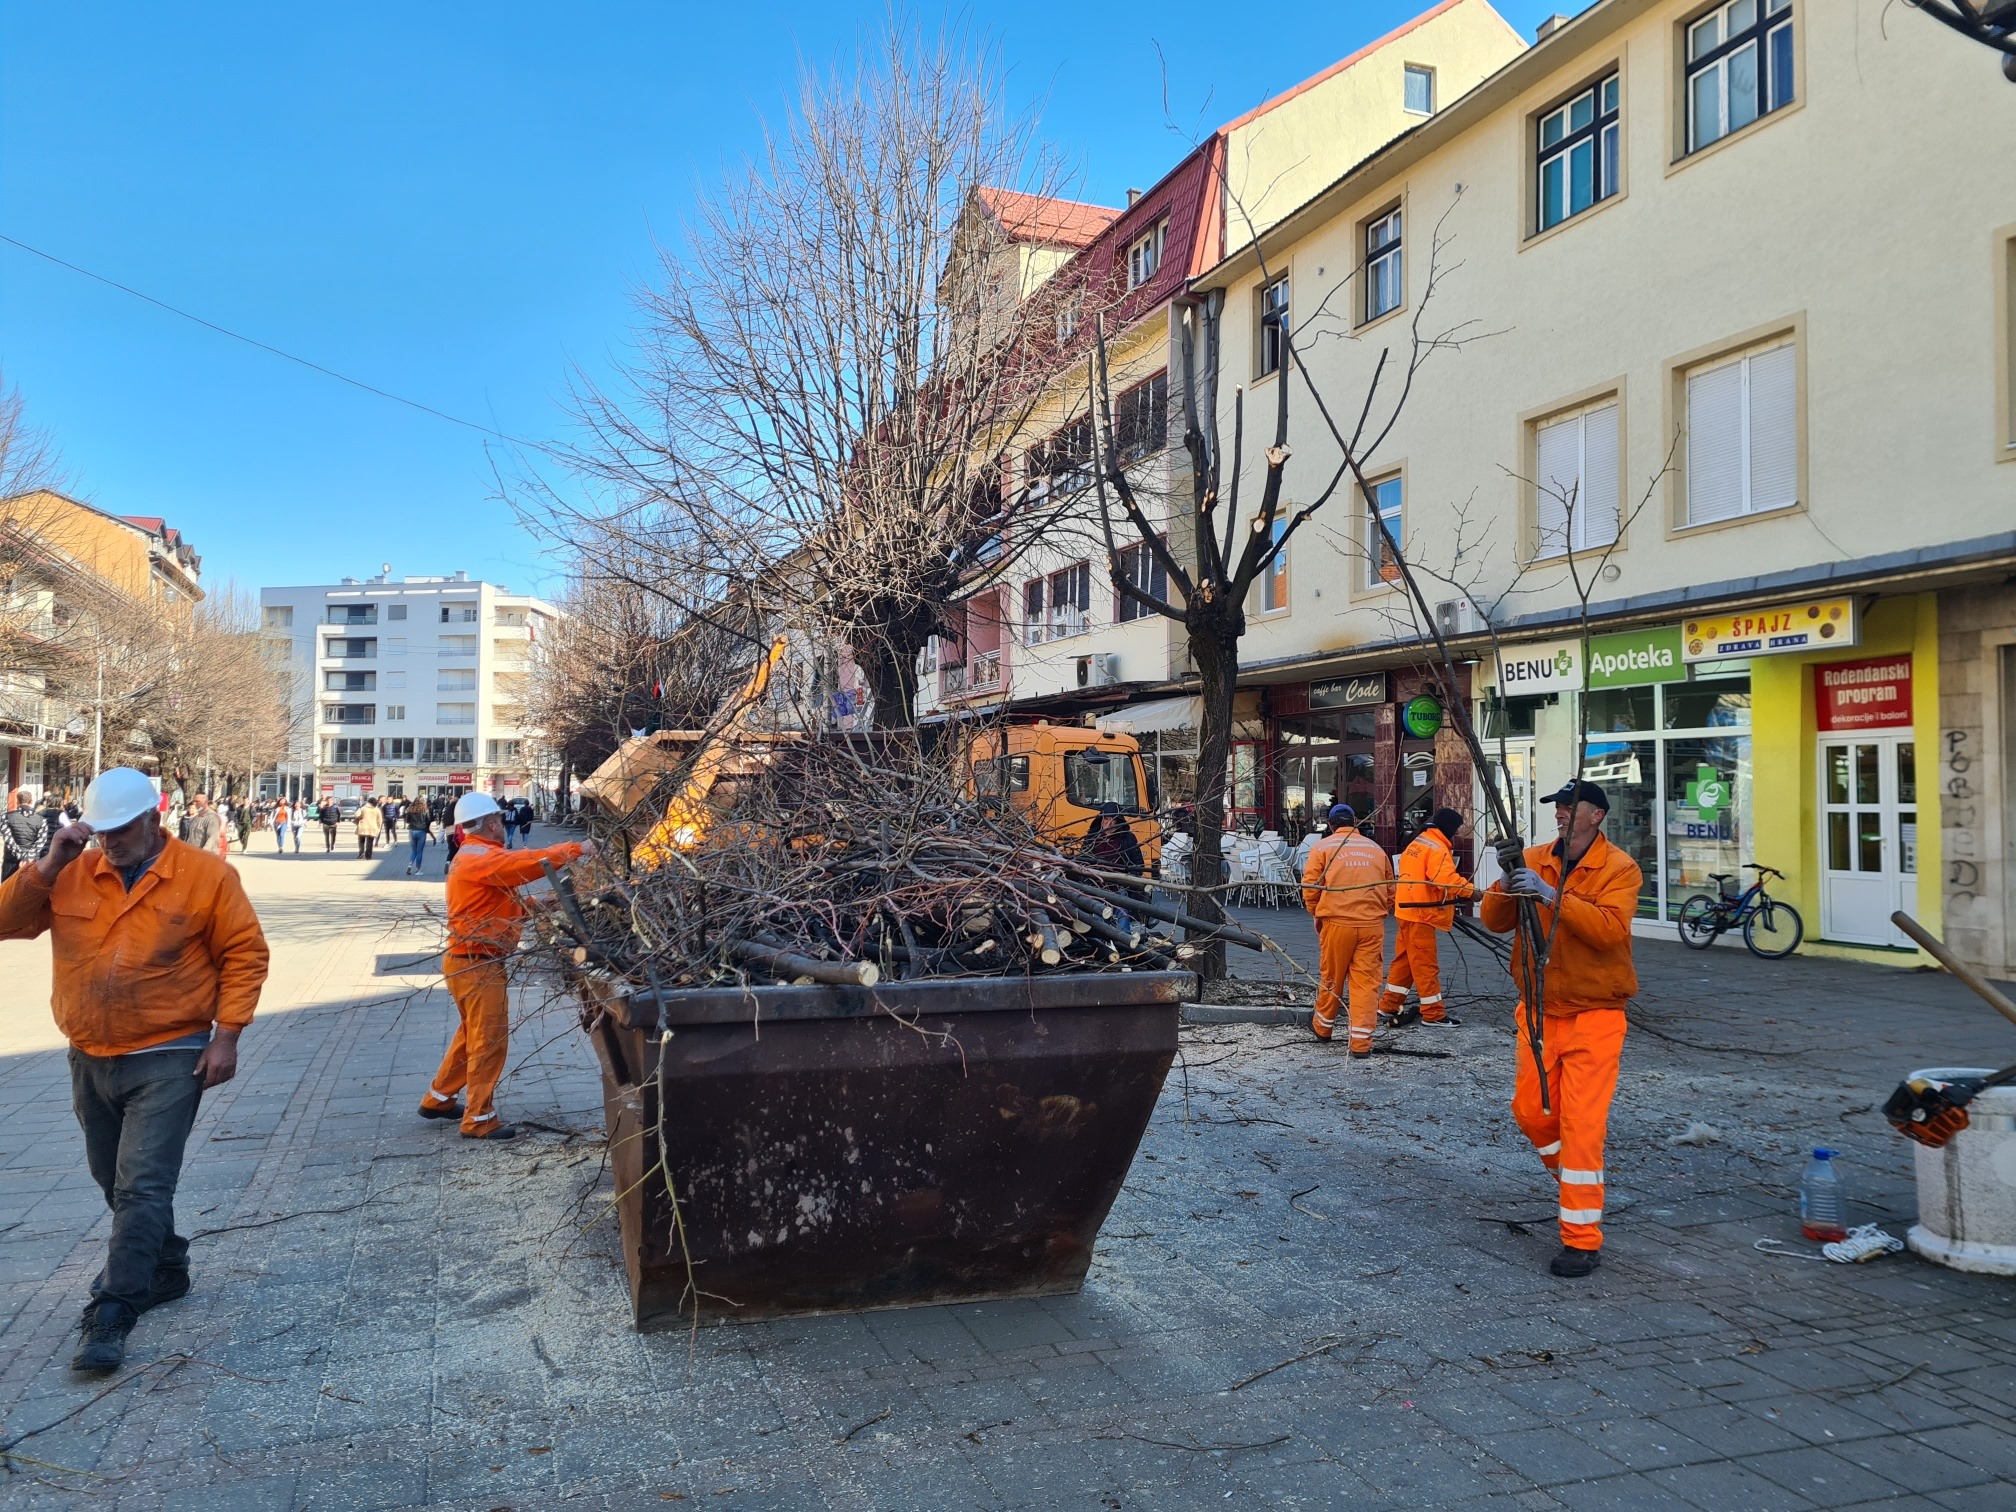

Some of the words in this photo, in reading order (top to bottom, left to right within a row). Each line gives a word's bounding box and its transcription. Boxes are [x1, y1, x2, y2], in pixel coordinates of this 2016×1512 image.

[1732, 613, 1792, 637] ŠPAJZ
[1719, 641, 1761, 653] ZDRAVA
[1769, 635, 1807, 647] HRANA
[1505, 658, 1552, 682] BENU
[1590, 643, 1673, 677] Apoteka
[1313, 685, 1329, 697] caffe
[1330, 682, 1342, 692] bar
[1345, 679, 1380, 702] Code
[1837, 685, 1897, 706] program
[1410, 711, 1441, 721] TUBORG
[1831, 712, 1874, 723] dekoracije
[1880, 710, 1908, 720] baloni
[1687, 823, 1731, 840] BENU
